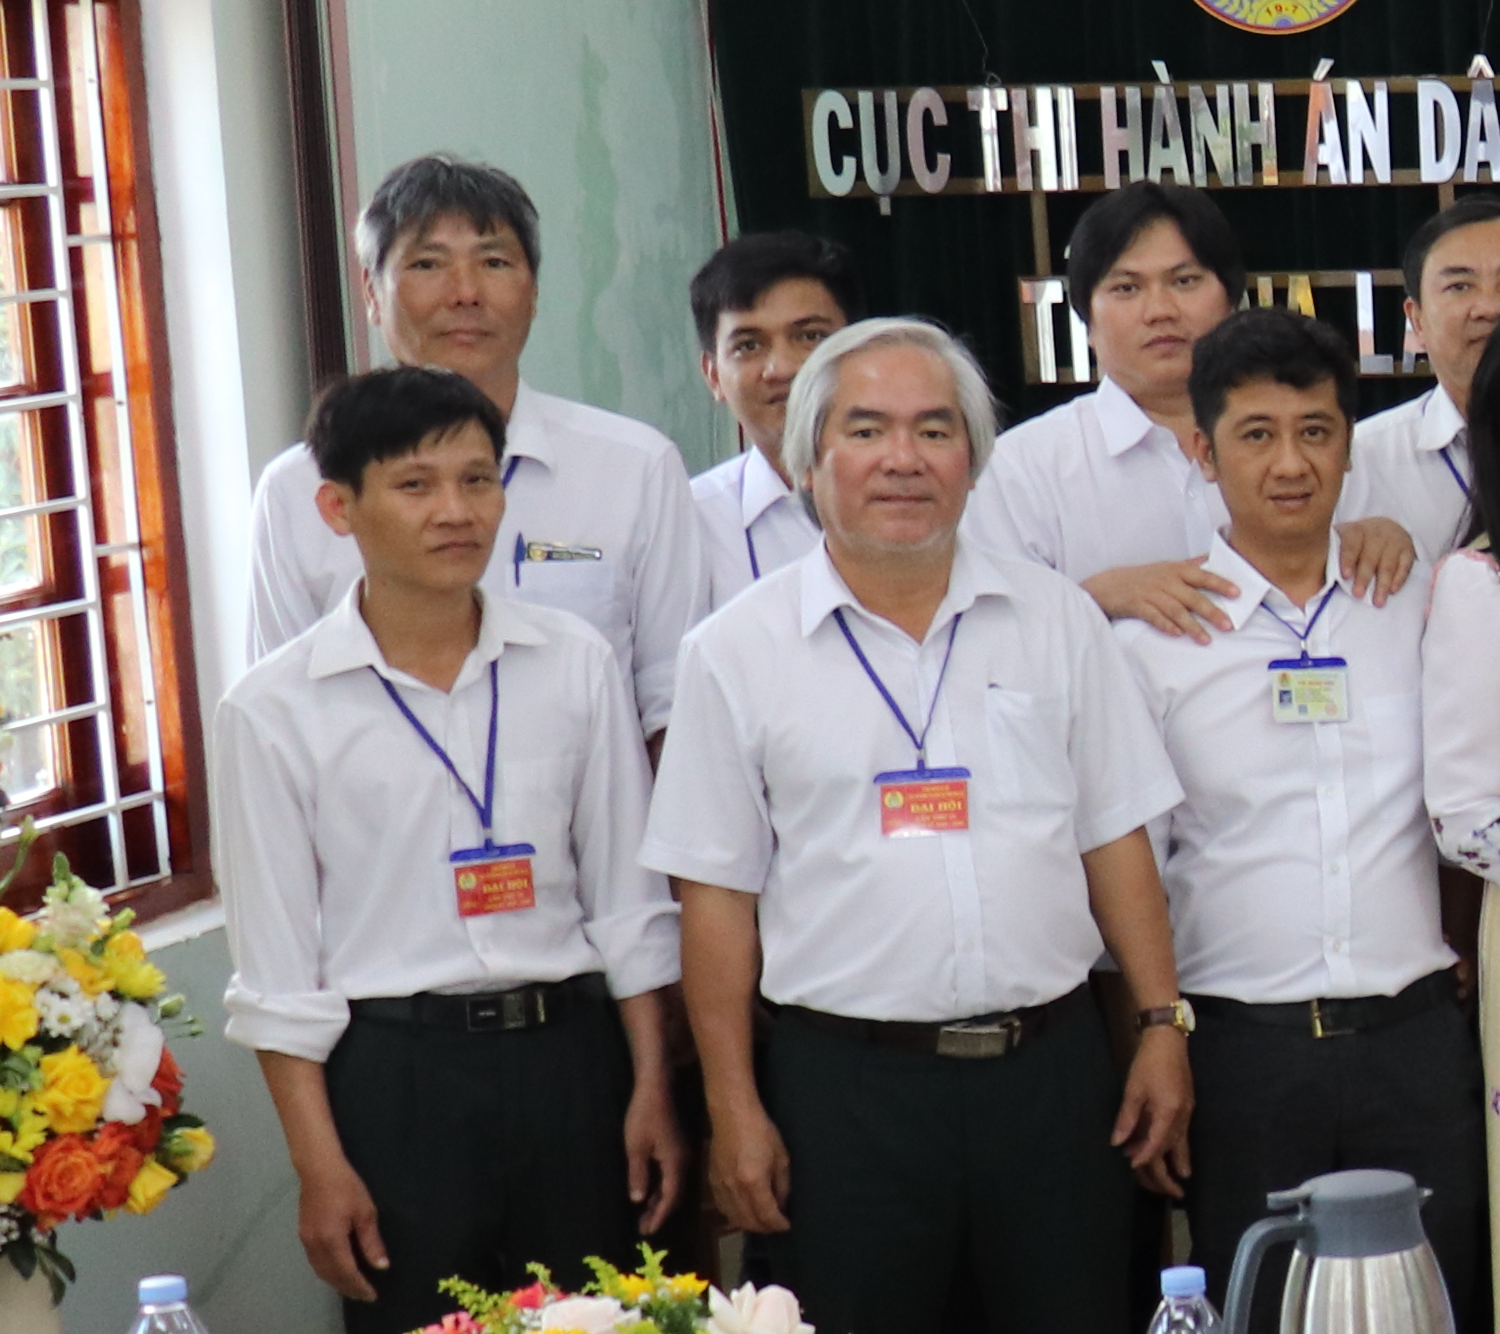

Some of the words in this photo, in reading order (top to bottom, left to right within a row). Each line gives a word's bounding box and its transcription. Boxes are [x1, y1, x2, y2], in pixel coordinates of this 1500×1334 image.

[812, 87, 952, 215] CỤC
[968, 83, 1079, 193] THI
[1100, 58, 1276, 190] HÀNH
[1303, 57, 1392, 187] ÁN
